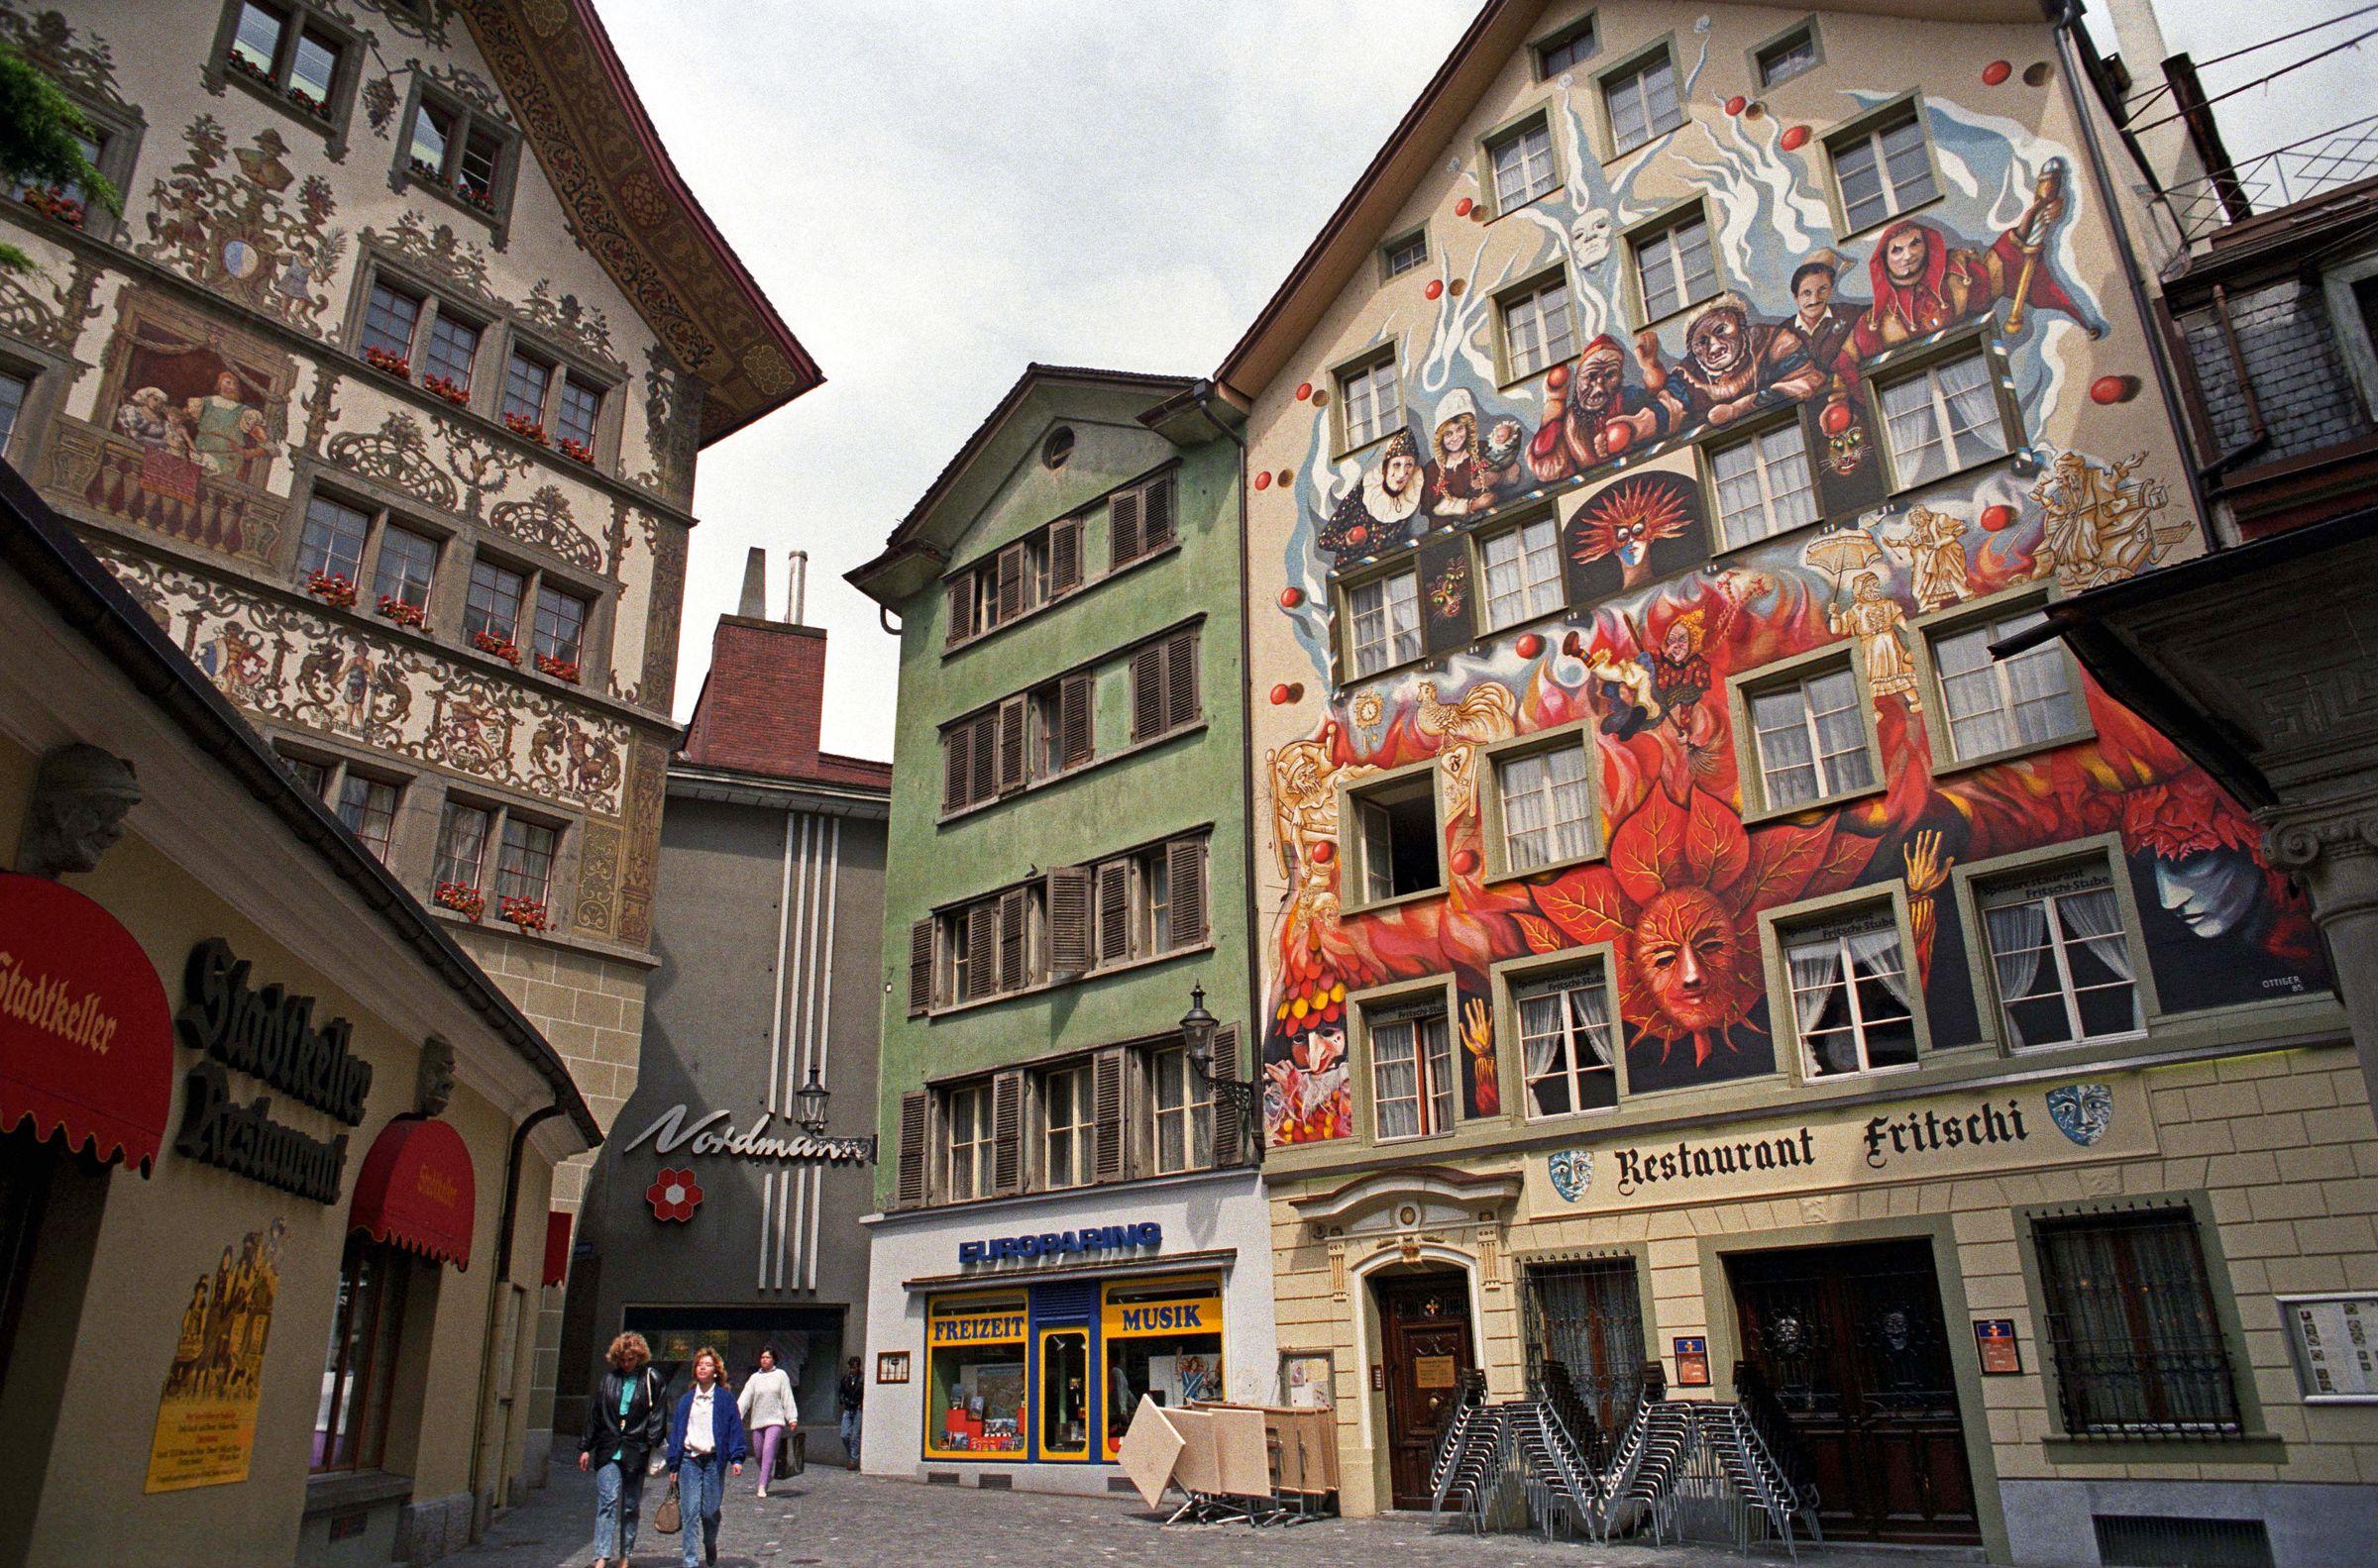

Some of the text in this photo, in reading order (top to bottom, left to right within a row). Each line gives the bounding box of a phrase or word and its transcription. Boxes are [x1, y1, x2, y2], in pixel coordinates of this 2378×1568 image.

[176, 936, 374, 1127] Stadtkeller
[174, 1061, 350, 1205] Restaurant
[1614, 1098, 2030, 1197] Restaurant Fritschi
[958, 1221, 1163, 1265] EUROPARING
[932, 1315, 1026, 1341] FREIZEIT
[1122, 1303, 1203, 1332] MUSIK
